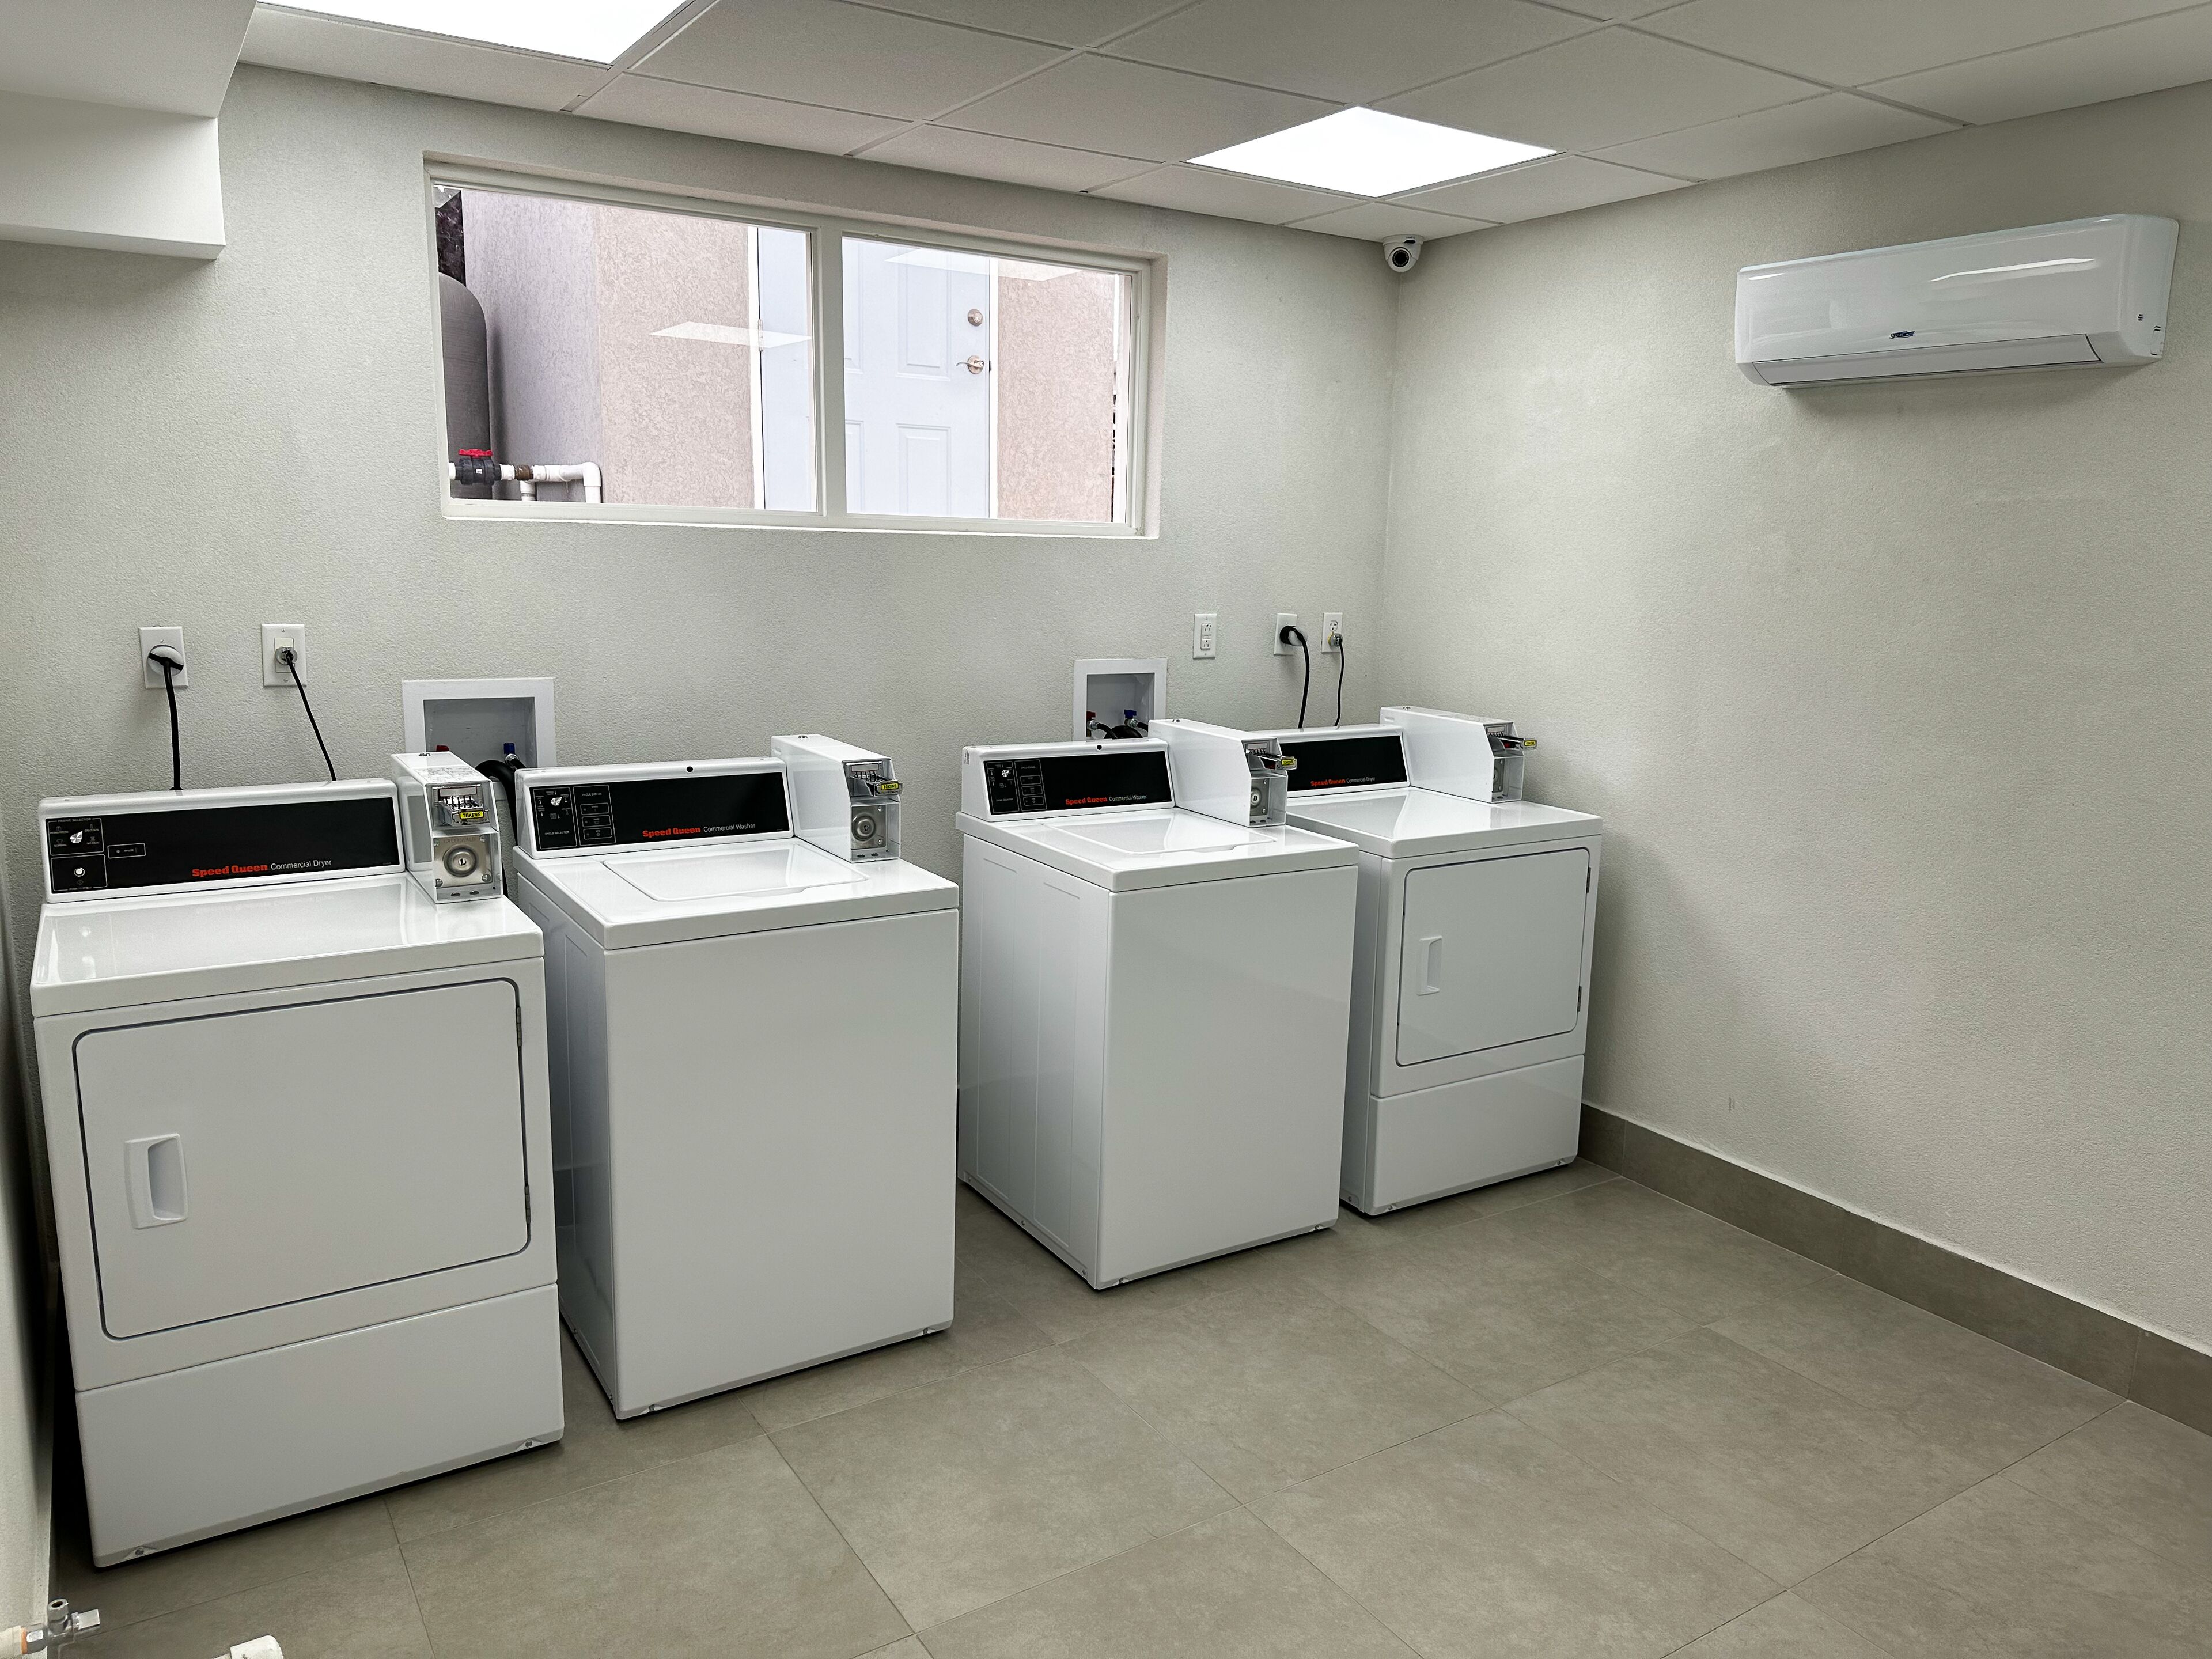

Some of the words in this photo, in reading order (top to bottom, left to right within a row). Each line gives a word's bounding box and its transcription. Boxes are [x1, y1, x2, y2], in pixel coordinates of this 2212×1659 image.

[1066, 797, 1086, 805] Speed
[642, 828, 671, 838] Speed
[672, 827, 701, 835] Queen
[703, 824, 735, 833] Commercial
[192, 866, 230, 877] Speed
[231, 864, 268, 873] Queen
[271, 861, 312, 870] Commercial
[313, 859, 332, 869] Dryer
